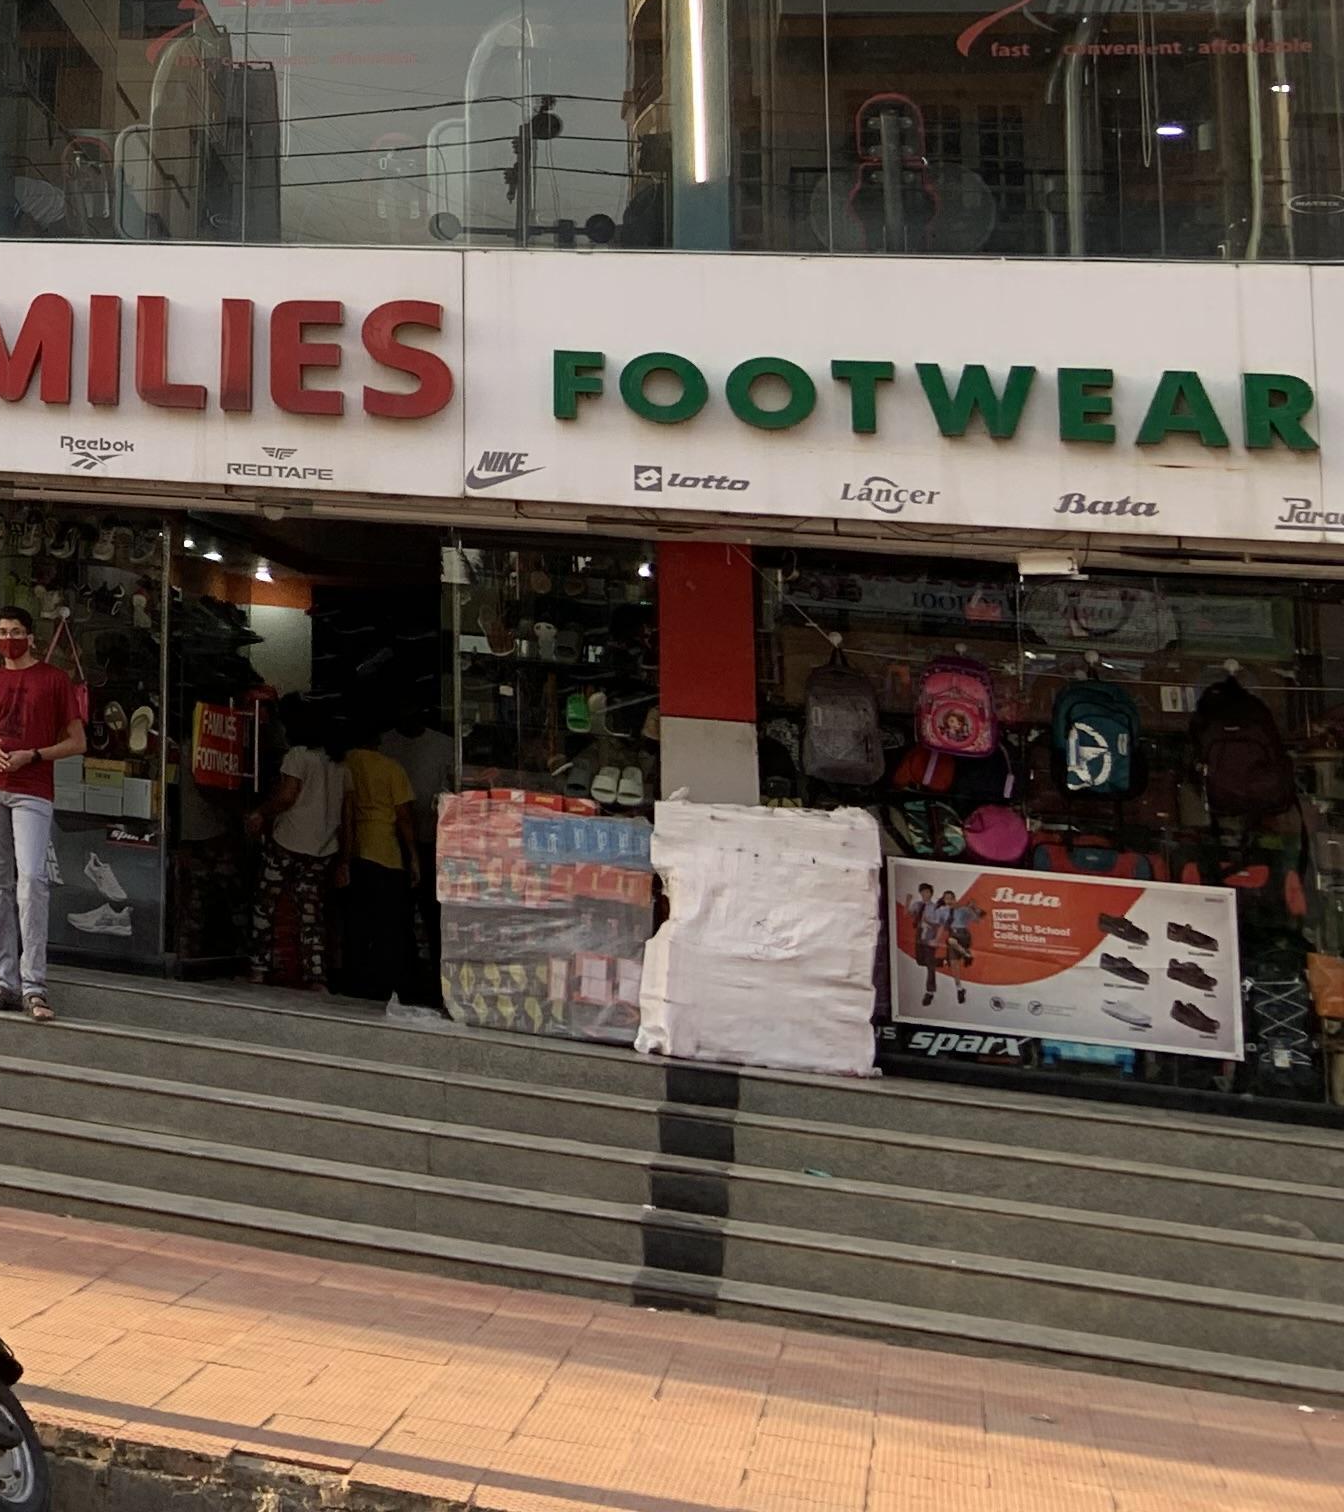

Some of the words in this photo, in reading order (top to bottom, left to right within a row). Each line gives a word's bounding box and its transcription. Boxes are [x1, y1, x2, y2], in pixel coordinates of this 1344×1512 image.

[991, 41, 1030, 58] fast
[1063, 39, 1182, 56] convenient
[552, 348, 1321, 453] FOOTWEAR
[60, 435, 136, 454] Reebok
[227, 463, 334, 481] REDTAPE
[478, 451, 530, 474] NIKE
[667, 473, 751, 492] lotto
[840, 480, 941, 508] Lancer
[1053, 492, 1160, 517] Bata
[1278, 497, 1344, 525] Para
[195, 746, 240, 774] FOOTWEAR
[992, 887, 1062, 908] Bata
[993, 921, 1019, 932] Back
[1021, 924, 1033, 933] to
[1034, 925, 1071, 937] School
[993, 930, 1047, 944] Collection
[908, 1031, 1030, 1058] sparx
